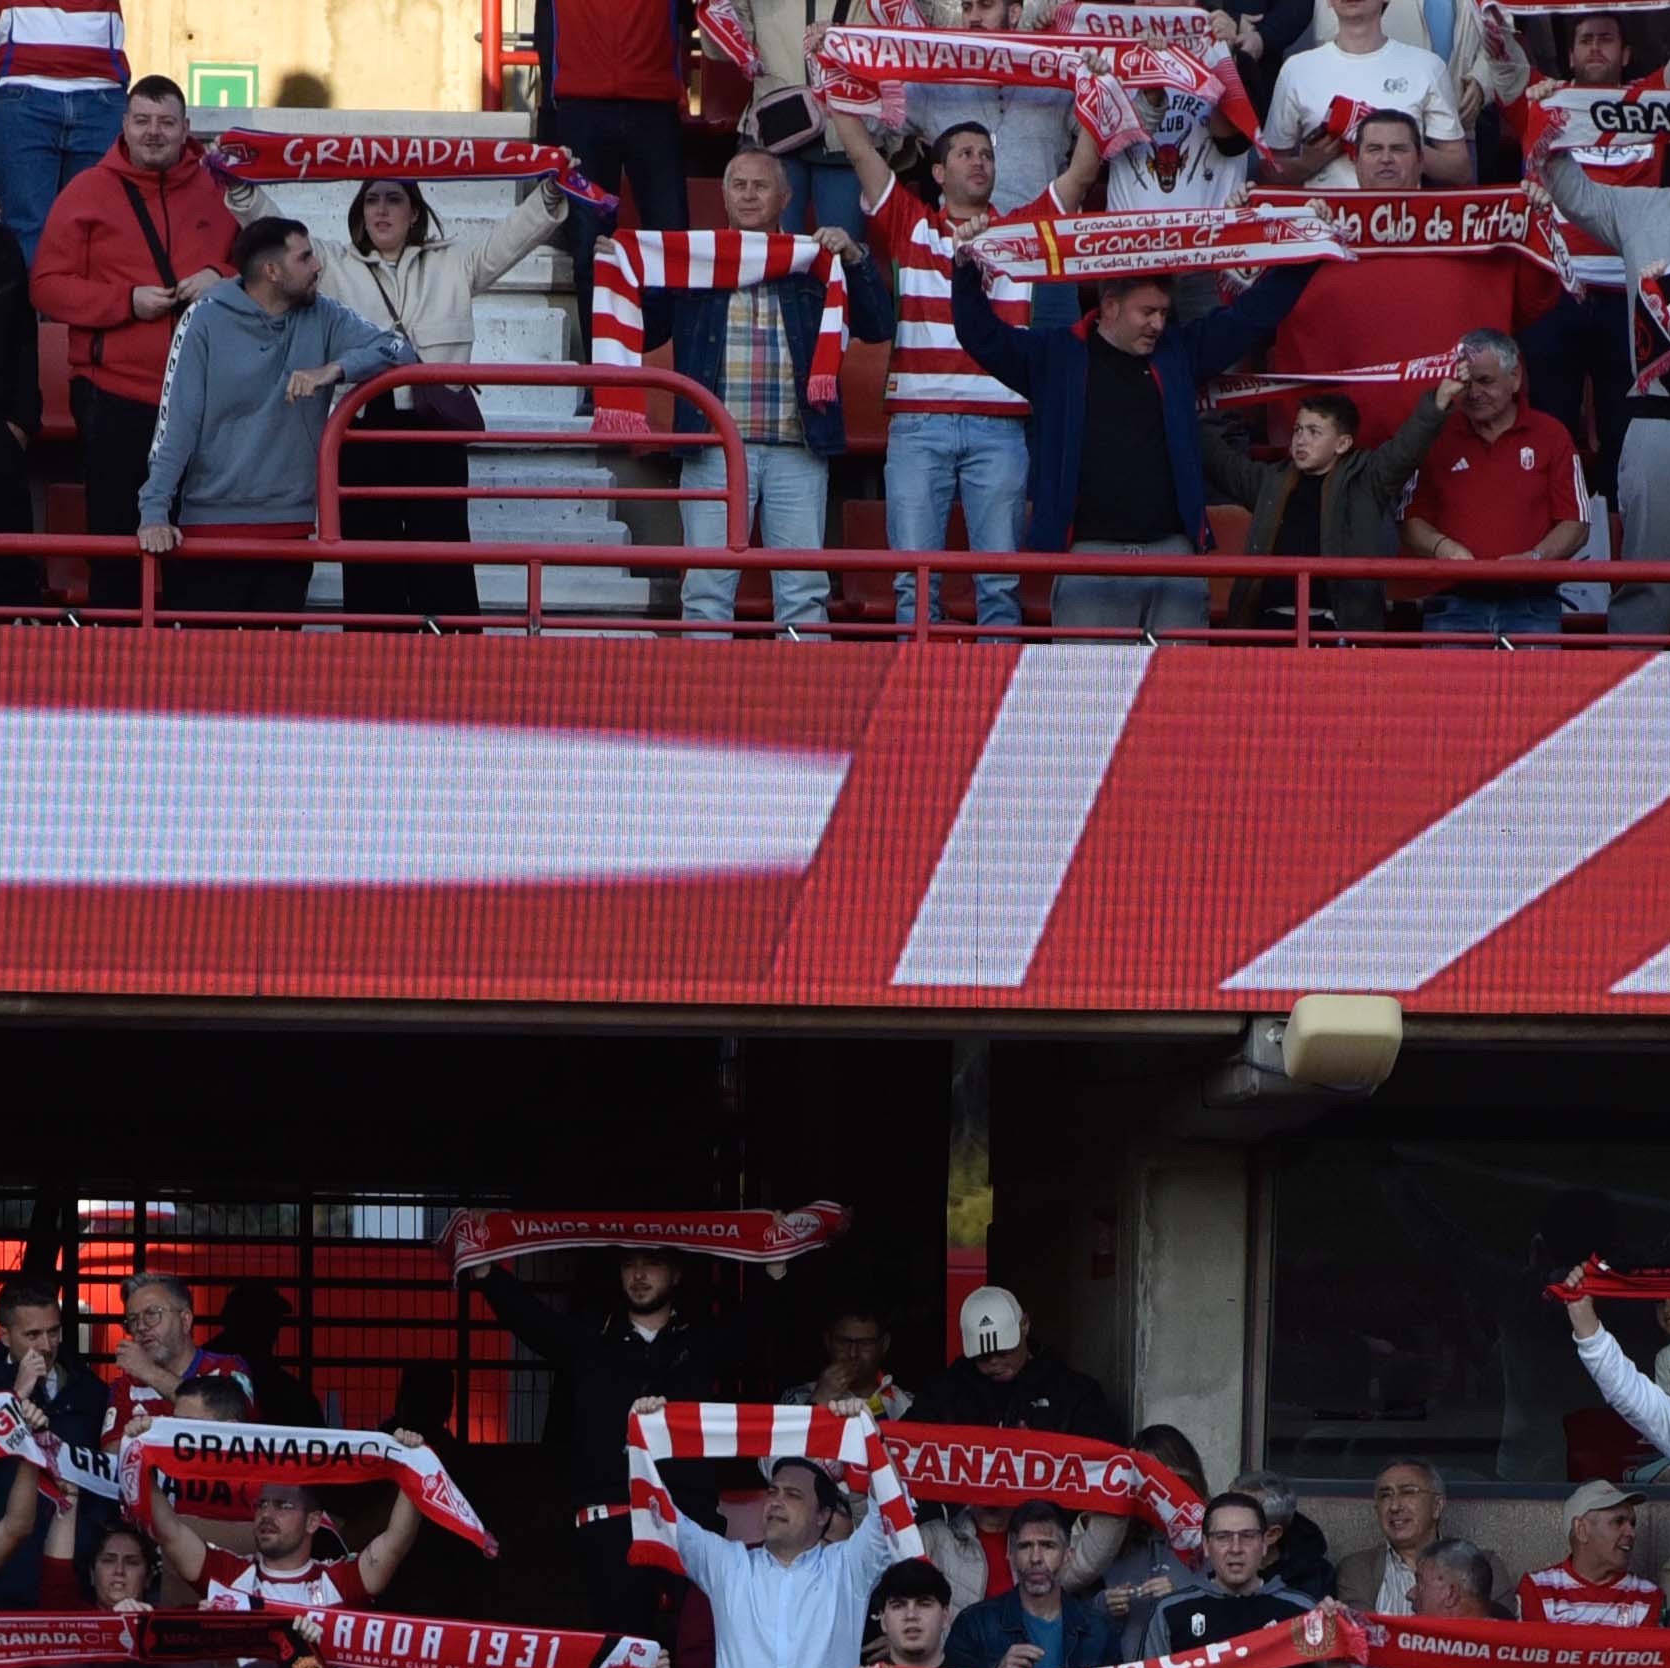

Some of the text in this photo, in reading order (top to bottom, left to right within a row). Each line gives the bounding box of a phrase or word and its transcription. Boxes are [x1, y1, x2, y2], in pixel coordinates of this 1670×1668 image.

[1085, 13, 1209, 39] GRANAD
[821, 32, 1014, 77] GRANADA
[1030, 47, 1085, 84] CF
[282, 137, 476, 178] GRANADA
[1072, 209, 1226, 231] Granada Club de Fútbol
[1370, 205, 1418, 243] Club
[1424, 206, 1454, 243] de
[1461, 198, 1530, 246] Fútbol
[1074, 226, 1222, 257] Granada CF
[1074, 258, 1089, 271] Tu
[511, 1220, 591, 1237] VAMOS
[634, 1221, 740, 1239] GRANADA
[883, 1438, 1088, 1493] RANADA
[336, 1652, 400, 1668] GRANADA
[1397, 1631, 1665, 1667] GRANADA CLUB DE FÚTBOL
